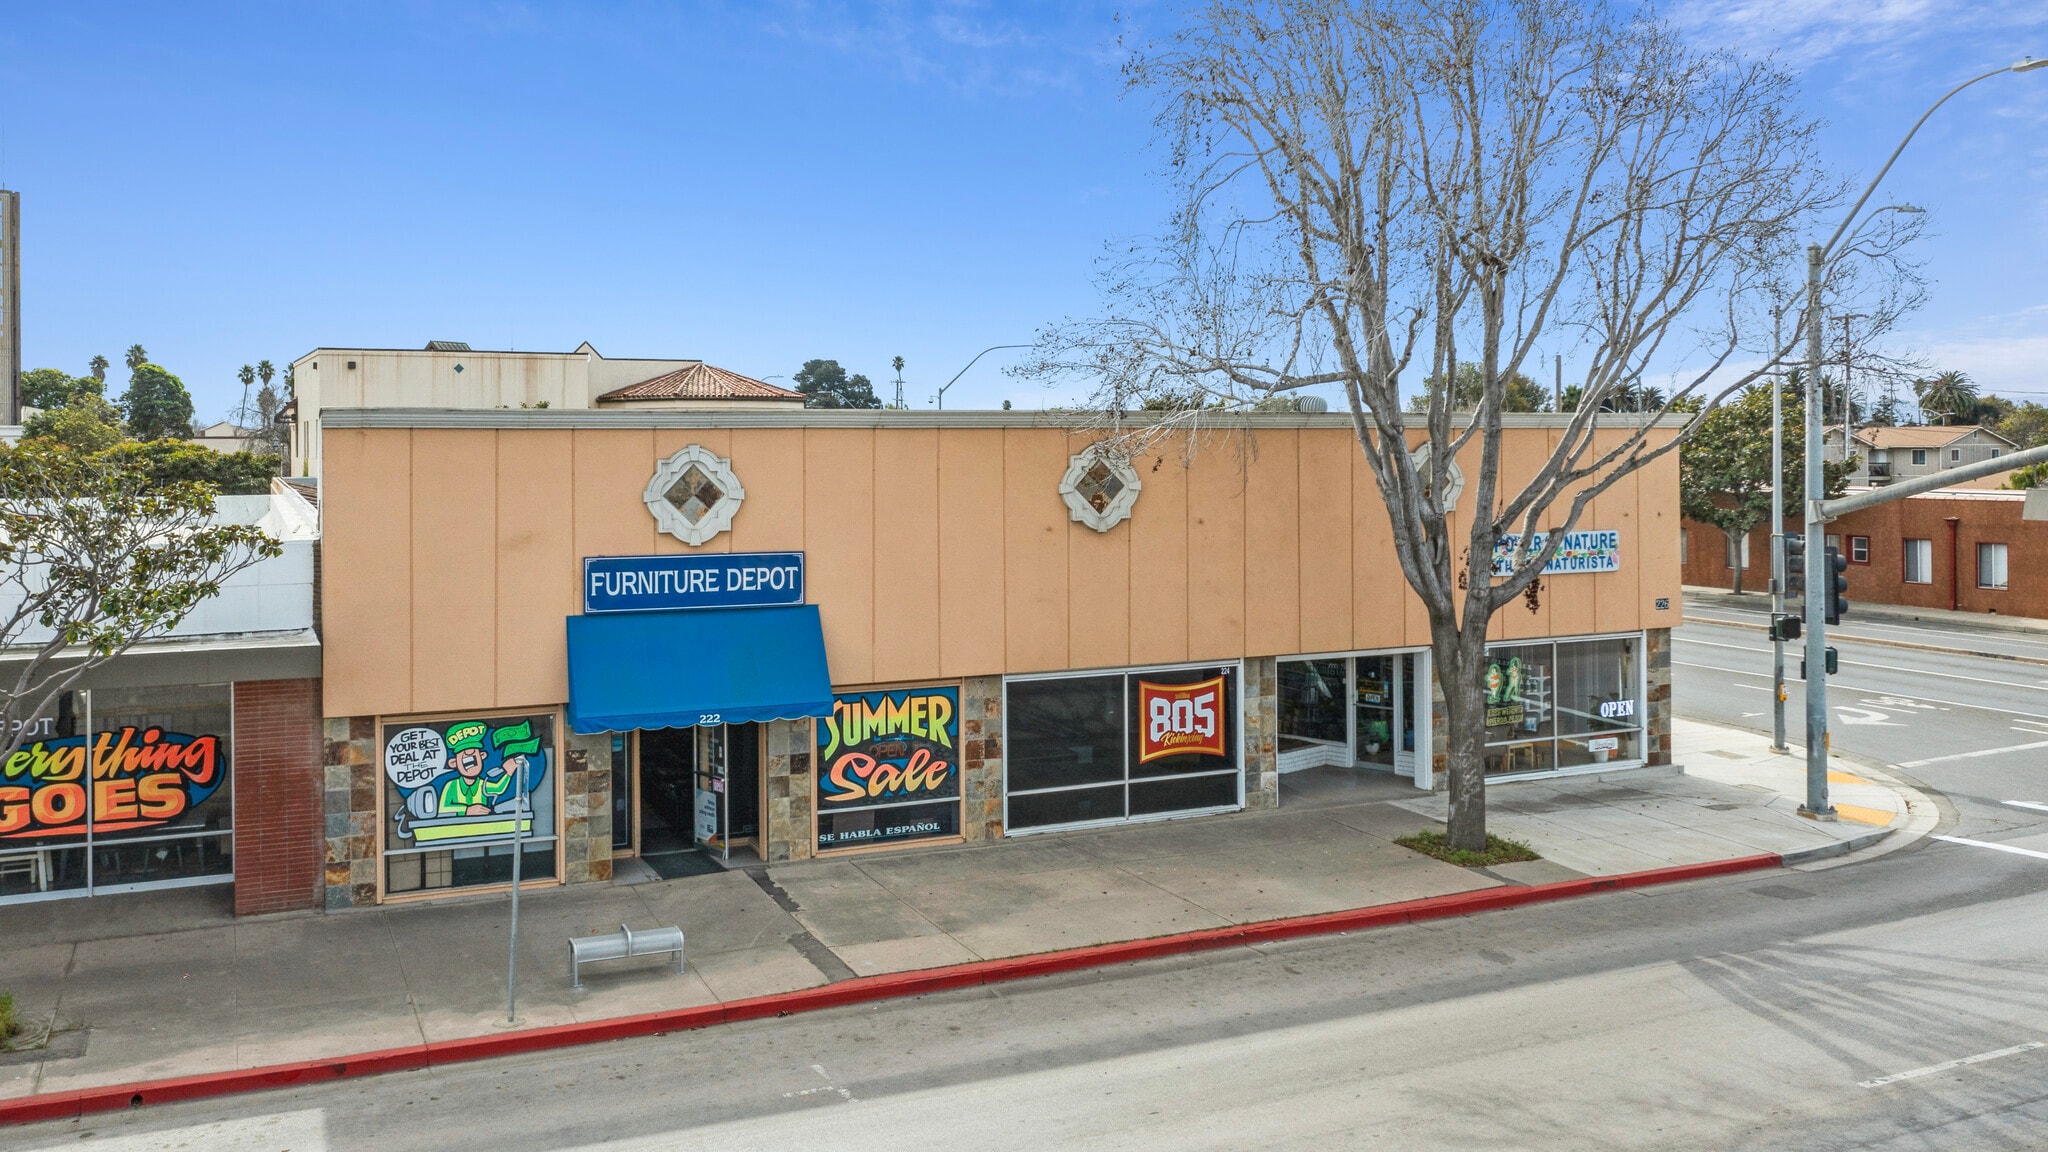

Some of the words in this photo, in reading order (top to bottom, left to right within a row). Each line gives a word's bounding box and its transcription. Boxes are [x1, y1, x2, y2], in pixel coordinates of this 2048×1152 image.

[1564, 532, 1616, 550] NATURE
[1547, 555, 1614, 571] NATURISTA
[590, 568, 720, 596] FURNITURE
[726, 566, 799, 592] DEPOT
[1656, 599, 1669, 609] 226
[1150, 691, 1214, 742] 805
[1600, 699, 1634, 718] OPEN
[700, 714, 721, 723] 222
[448, 725, 485, 745] DEPOT
[824, 695, 953, 761] SUMMER
[390, 742, 417, 753] YOUR
[419, 738, 440, 750] BEST
[401, 731, 427, 743] GET
[390, 752, 419, 766] DEAL
[423, 749, 440, 760] AT
[870, 743, 904, 757] OPEN
[403, 761, 428, 770] THE
[397, 767, 437, 783] DEPOT
[824, 748, 948, 801] Sale
[0, 773, 186, 833] GOES
[819, 833, 835, 842] SE
[840, 828, 881, 840] HABLA
[886, 822, 941, 836] ESPAÑOL
